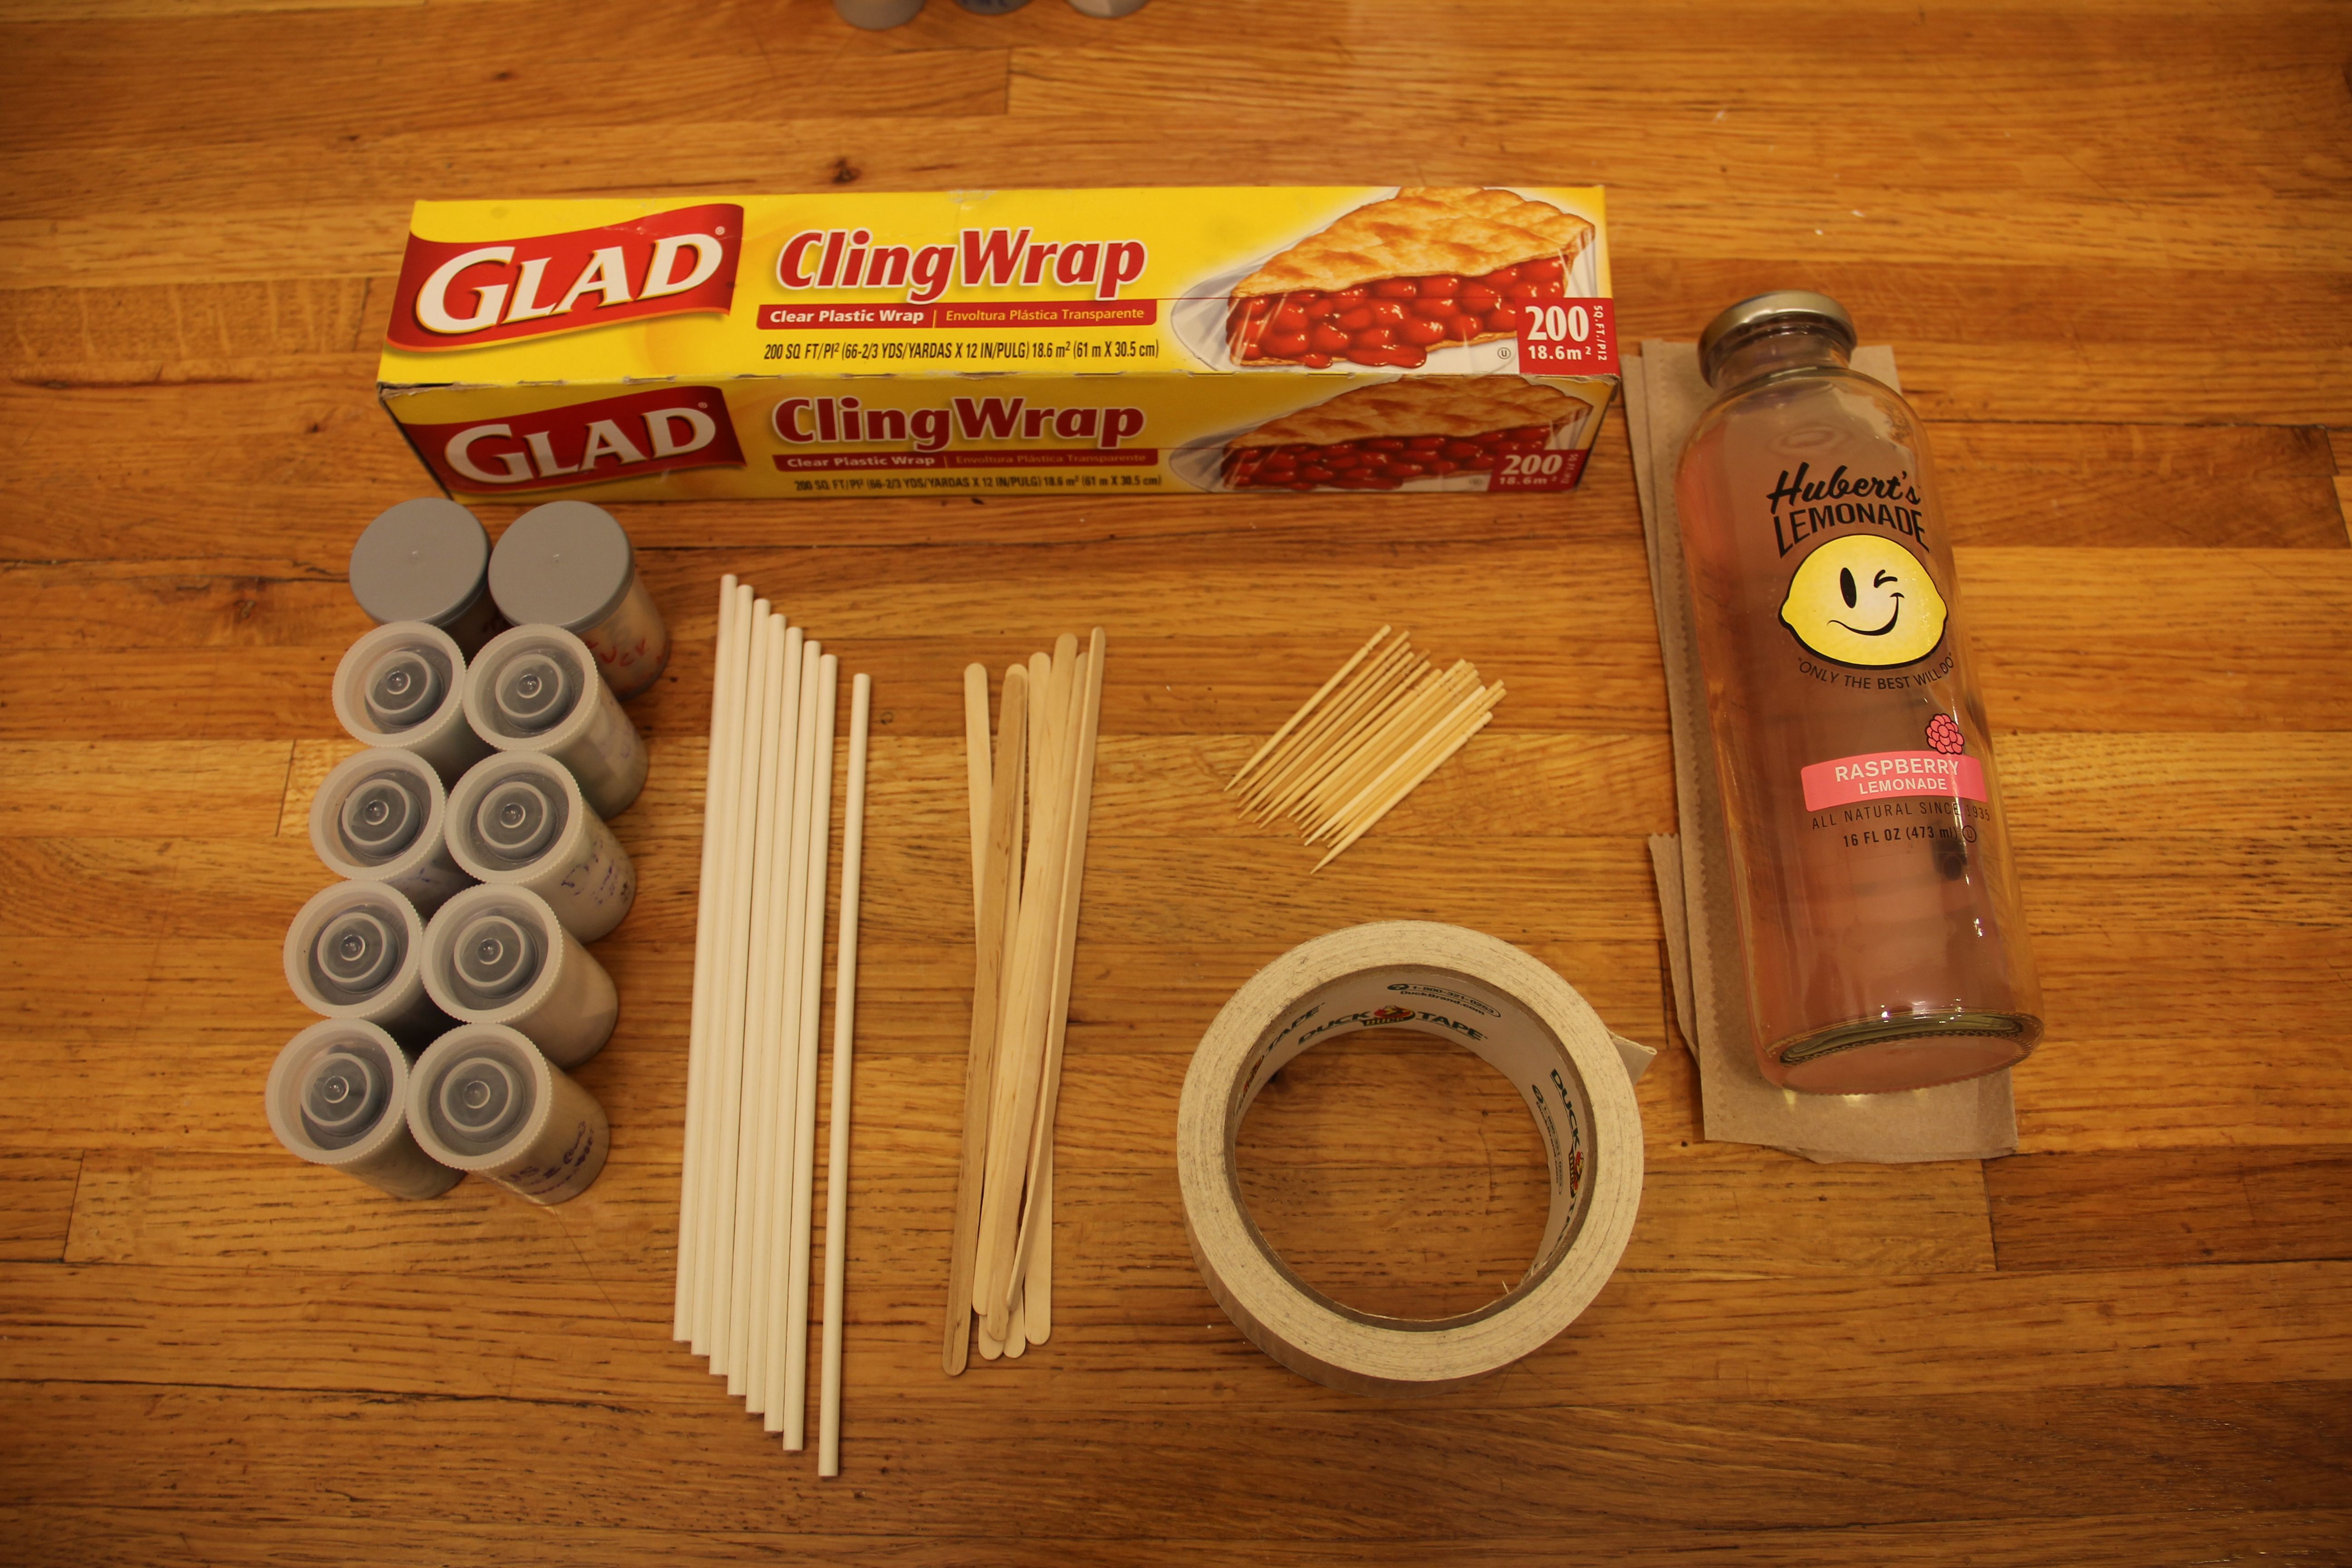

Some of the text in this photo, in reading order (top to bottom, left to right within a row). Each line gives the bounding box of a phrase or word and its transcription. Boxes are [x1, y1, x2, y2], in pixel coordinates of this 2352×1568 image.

[775, 226, 1148, 305] ClingWrap
[770, 309, 1144, 324] Clear Plastic Wrap Envoltura Plástica Transparente
[1525, 305, 1589, 342] 200
[764, 344, 783, 359] 200
[785, 343, 800, 359] SQ
[842, 342, 878, 360] (66-2/3
[882, 342, 952, 360] YDS/YARDAS
[955, 343, 965, 358] X
[966, 343, 977, 358] 12
[980, 341, 1029, 359] IN/PULG)
[1032, 342, 1053, 358] 18.6
[1073, 341, 1088, 359] (61
[1092, 345, 1101, 357] m
[1104, 341, 1112, 357] X
[1115, 341, 1136, 357] 30.5
[1139, 339, 1159, 358] cm)
[772, 396, 1145, 452] ClingWrap
[787, 457, 828, 467] Clear
[834, 456, 887, 466] Plastic
[891, 456, 935, 467] Wrap
[1068, 454, 1146, 464] Transparente
[1500, 455, 1563, 475] 200
[794, 480, 813, 491] 200
[815, 480, 829, 490] SQ
[973, 477, 979, 487] X
[983, 477, 992, 487] 12
[1044, 476, 1063, 486] 18.6
[1111, 476, 1117, 485] X
[1120, 475, 1139, 485] 30.5
[1766, 461, 1921, 514] Hubert's
[1773, 503, 1930, 559] LEMONADE
[1798, 657, 1840, 683] "ONLY
[1844, 675, 1871, 689] THE
[1877, 676, 1910, 690] BEST
[1913, 668, 1942, 686] WILL
[1835, 758, 1959, 782] RASPBERRY
[1859, 778, 1947, 794] LEMONADE
[1812, 801, 1990, 830] ALL NATURAL SINCE 1935
[1843, 833, 1858, 847] 16
[1864, 831, 1879, 844] FL
[1884, 828, 1901, 841] OZ
[1906, 826, 1934, 840] (473
[1940, 827, 1958, 839] ml)
[1400, 990, 1485, 1016] DuckBrand.com
[1298, 1011, 1371, 1045] DUCK
[1417, 1011, 1484, 1040] TAPE
[1551, 1068, 1581, 1151] DUCK
